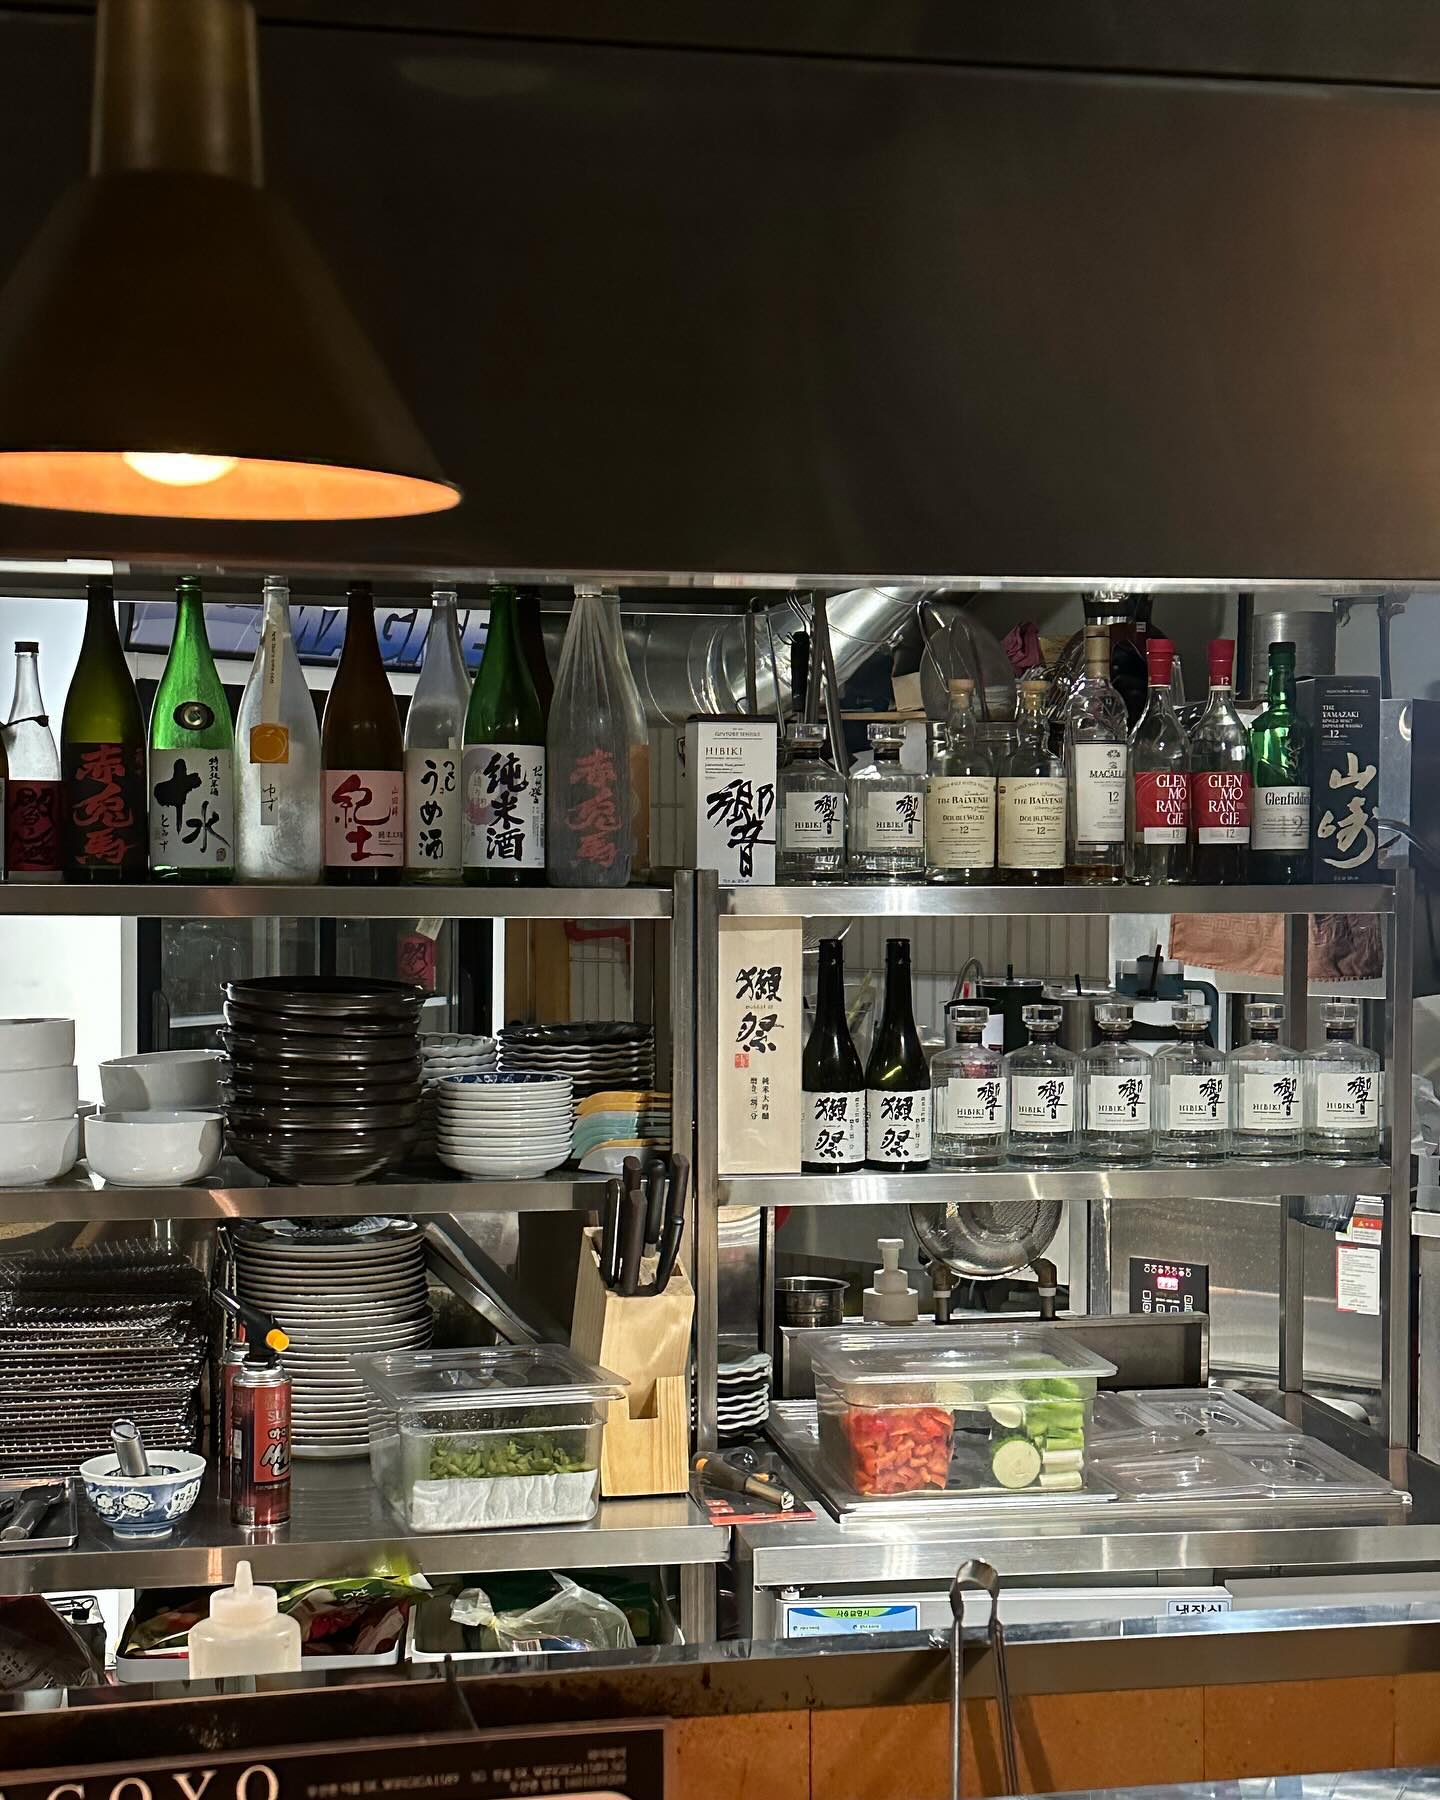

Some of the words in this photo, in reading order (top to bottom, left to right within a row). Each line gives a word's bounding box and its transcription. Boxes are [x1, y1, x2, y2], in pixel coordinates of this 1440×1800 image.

[1330, 729, 1340, 738] 12
[705, 746, 743, 756] HIBIKI
[1156, 774, 1187, 788] GLEN
[1208, 774, 1243, 788] GLEN
[1108, 791, 1120, 803] 12
[1168, 787, 1187, 800] MO
[1220, 786, 1244, 800] MO
[483, 751, 529, 862] 純米酒
[1156, 800, 1181, 813] RAN
[1208, 800, 1237, 813] RAN
[1317, 752, 1379, 870] 山崎
[1166, 813, 1184, 825] GIE
[1219, 812, 1240, 825] GIE
[794, 821, 823, 829] HIBIKI
[876, 821, 904, 829] HIBIKI
[960, 825, 969, 834] 12
[1036, 826, 1046, 835] 12
[1171, 829, 1181, 839] 12
[1225, 829, 1235, 839] 12
[735, 966, 785, 1054] 獺祭
[1018, 1106, 1046, 1114] HIBIKI
[1098, 1104, 1127, 1113] HIBIKI
[1179, 1104, 1207, 1112] HIBIKI
[1253, 1103, 1281, 1111] HIBIKI
[1326, 1102, 1355, 1110] HIBIKI
[956, 1108, 985, 1116] HIBIKI
[814, 1096, 849, 1159] 獺祭
[880, 1095, 915, 1158] 獺祭
